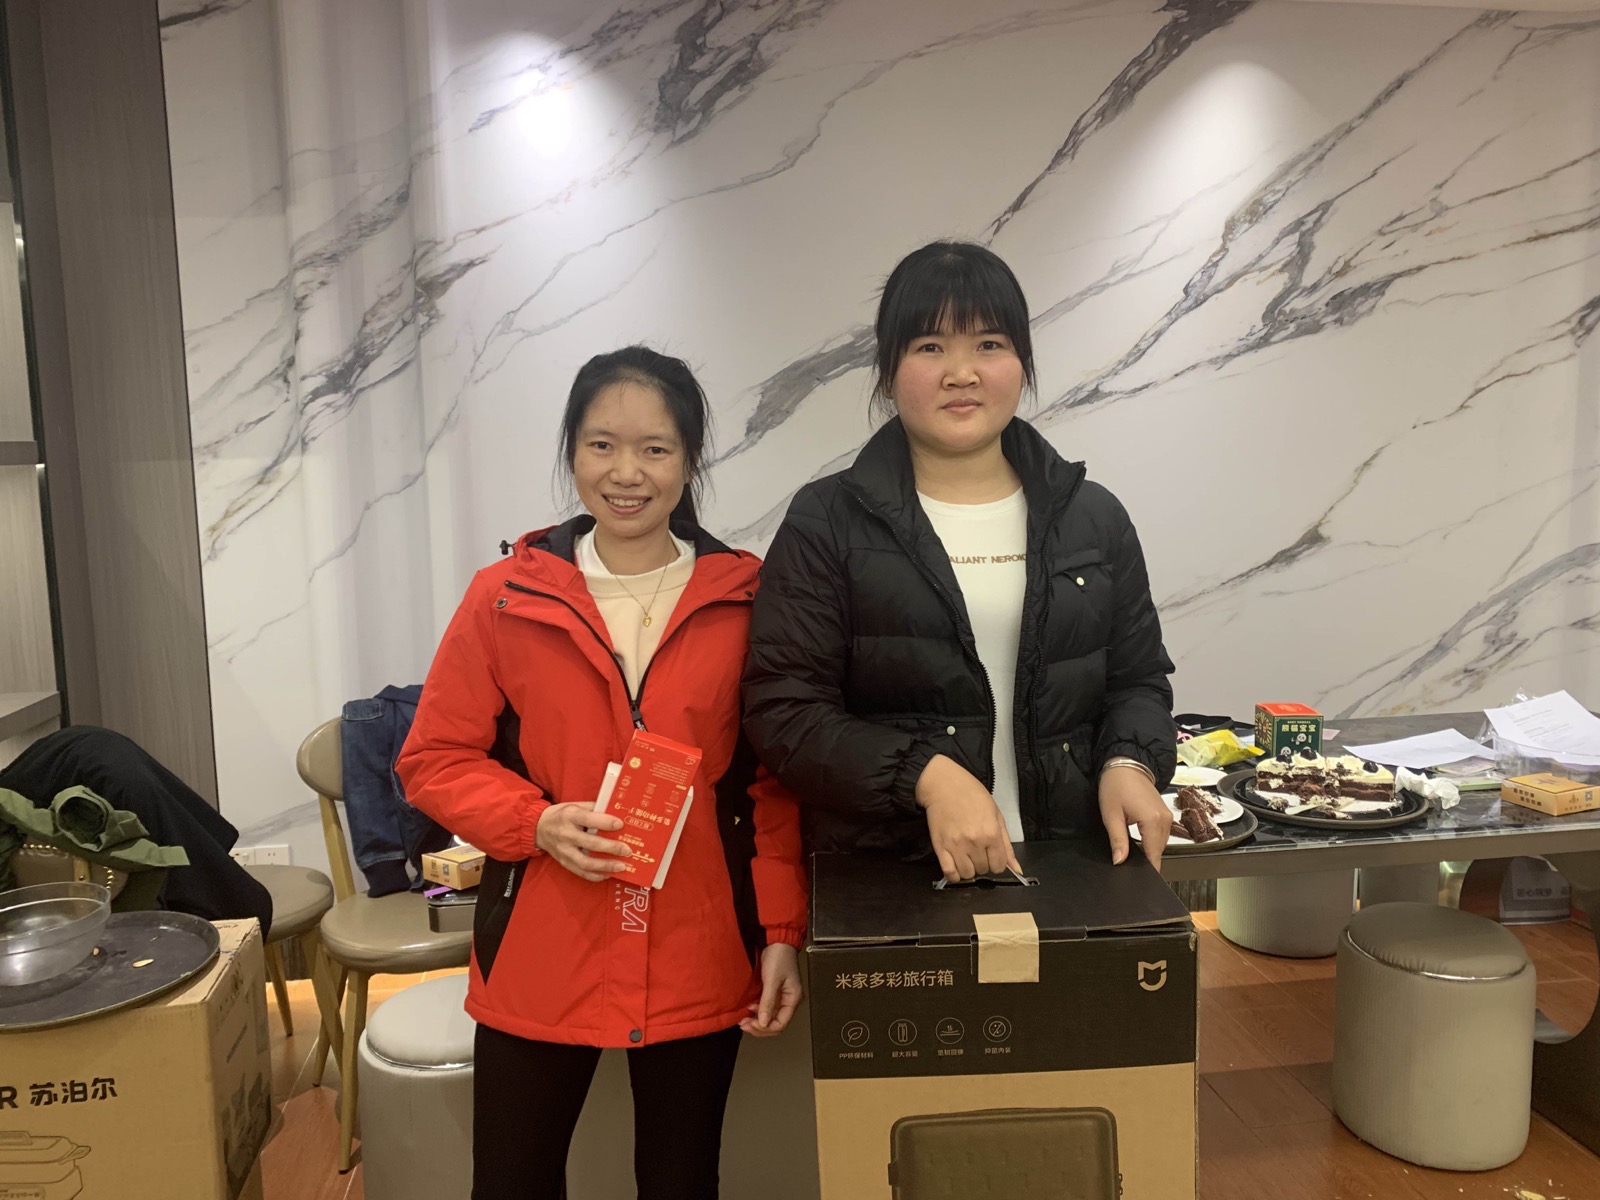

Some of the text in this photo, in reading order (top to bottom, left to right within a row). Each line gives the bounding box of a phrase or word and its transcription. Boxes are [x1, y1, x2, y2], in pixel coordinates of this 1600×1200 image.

[949, 556, 987, 564] ALIANT
[835, 969, 954, 989] 米家多彩旅行箱
[892, 1050, 918, 1058] 超大容量
[29, 1077, 118, 1106] 苏泊尔
